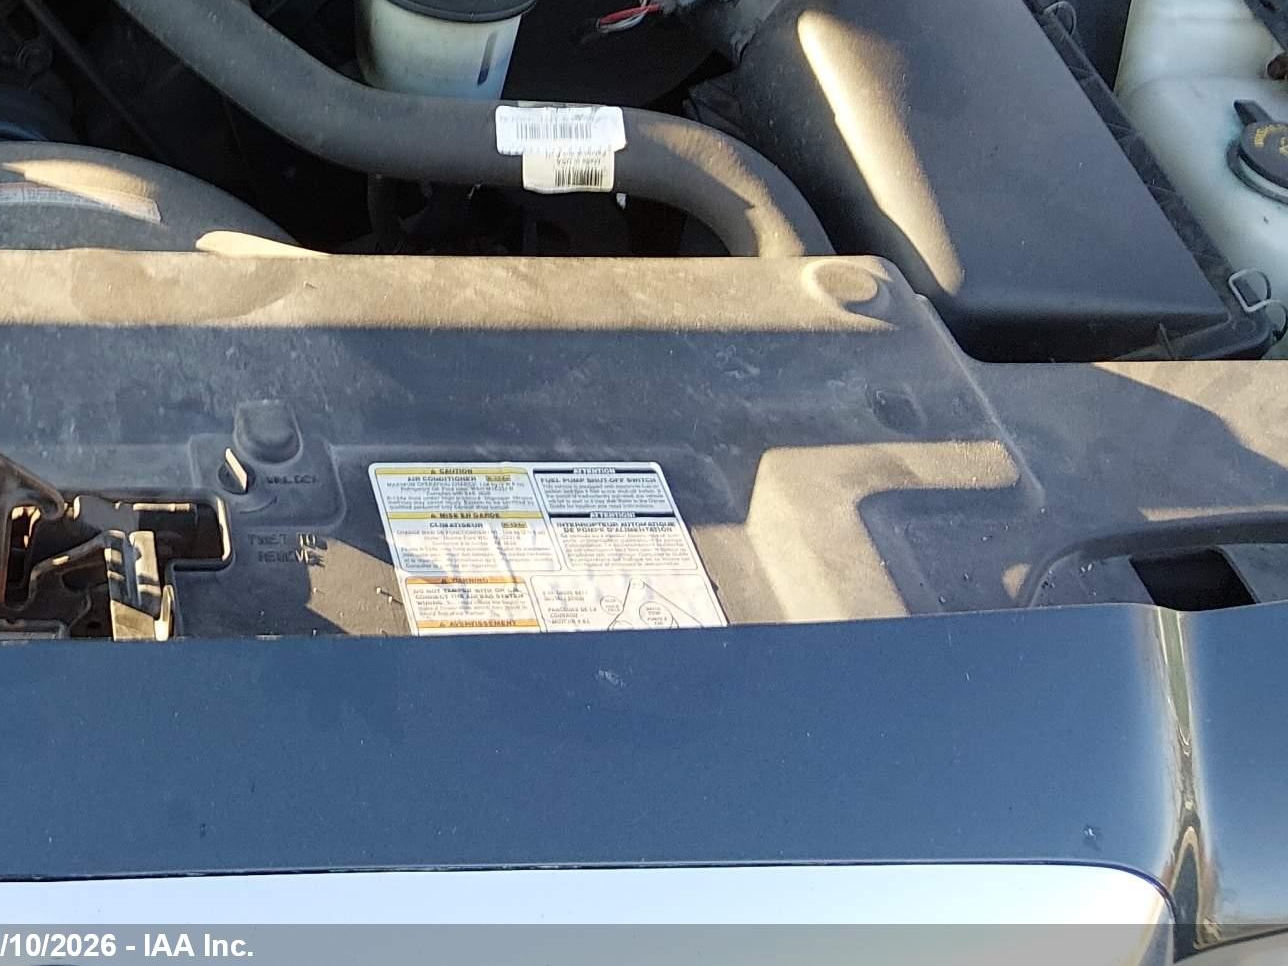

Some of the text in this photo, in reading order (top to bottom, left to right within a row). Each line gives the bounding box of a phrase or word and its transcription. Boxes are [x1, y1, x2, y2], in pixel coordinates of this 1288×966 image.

[573, 467, 616, 475] ATTENTION
[265, 474, 320, 484] UNLOCK
[450, 619, 517, 627] AVERTISSEMENT
